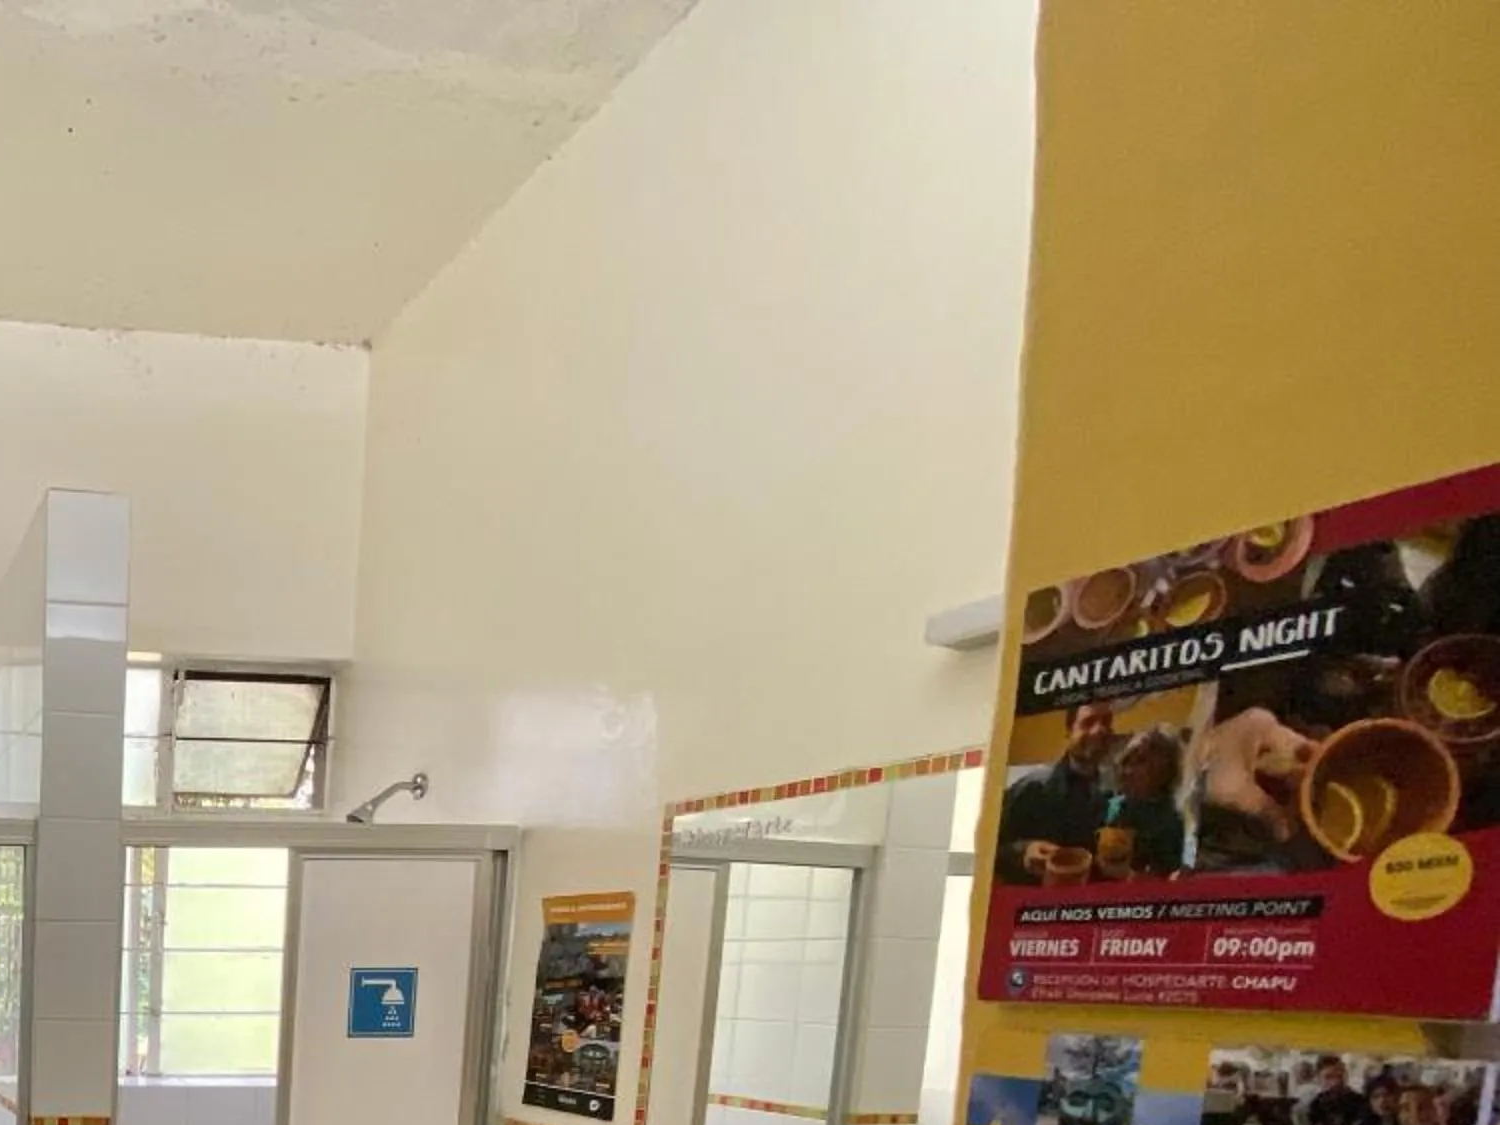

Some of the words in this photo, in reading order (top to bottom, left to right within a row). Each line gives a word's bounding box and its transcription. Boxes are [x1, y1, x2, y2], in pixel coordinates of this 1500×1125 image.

[1033, 632, 1225, 695] CANTARITOS
[1239, 606, 1345, 653] NIGHT
[1061, 908, 1093, 921] NOS
[1097, 905, 1153, 920] VEMOS
[1170, 902, 1248, 919] MEETING
[1252, 900, 1312, 916] POINT
[1010, 939, 1080, 957] VIERNES
[1100, 938, 1168, 957] FRIDAY
[1213, 937, 1315, 962] 09:00pm
[1231, 975, 1297, 990] CHAPU
